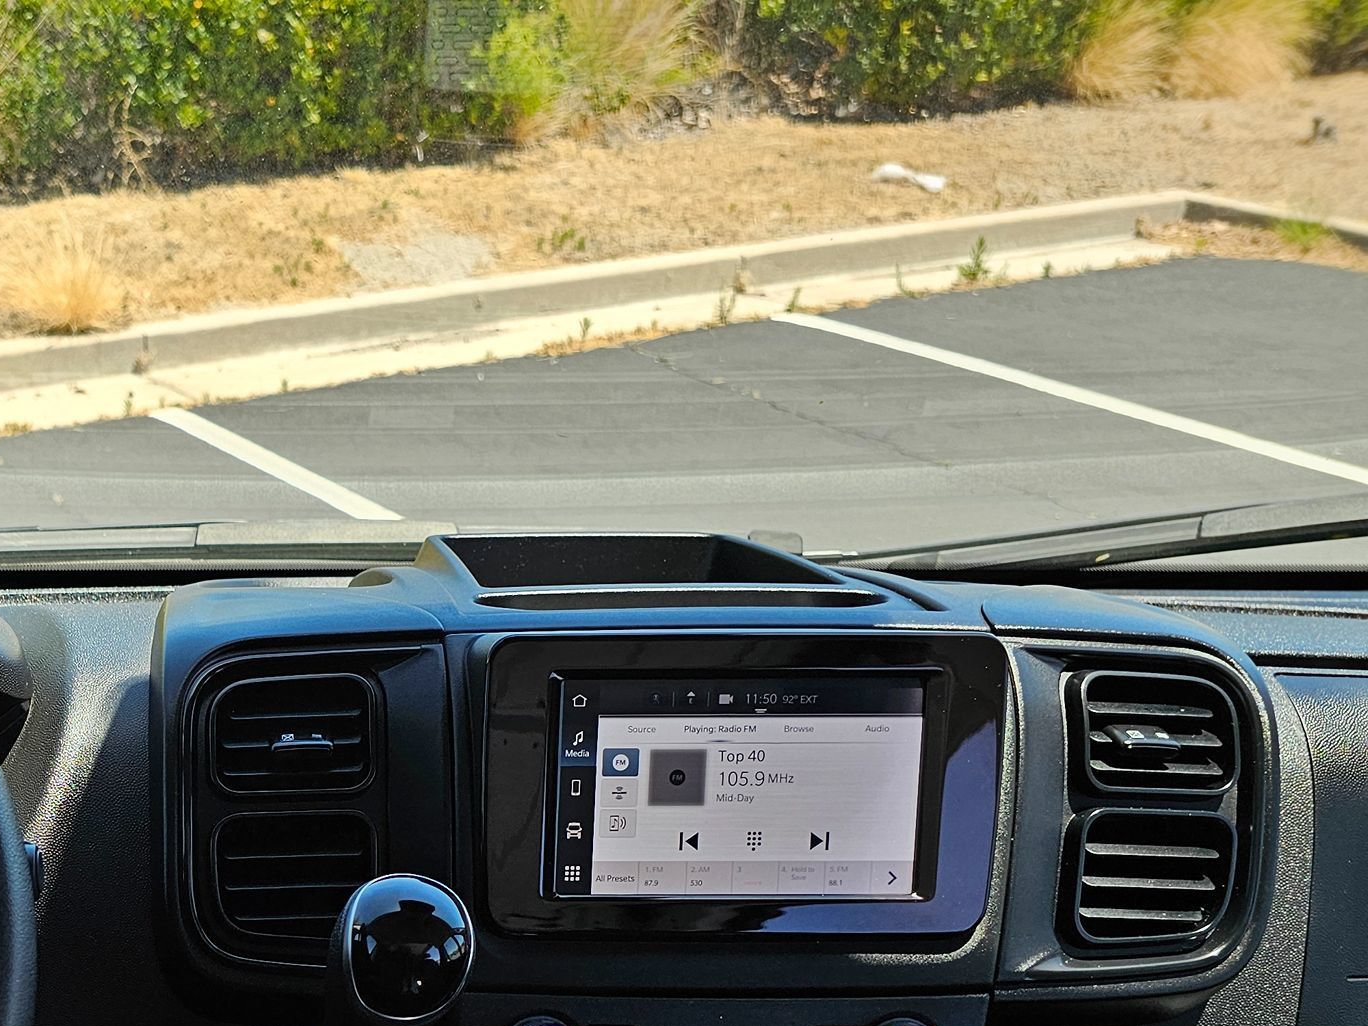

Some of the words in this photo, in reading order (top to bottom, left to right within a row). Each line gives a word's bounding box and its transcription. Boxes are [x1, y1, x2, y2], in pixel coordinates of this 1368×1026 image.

[746, 693, 777, 704] 11:50
[782, 694, 799, 704] 92°
[801, 695, 818, 704] EXT
[627, 725, 656, 733] Source
[684, 725, 717, 735] Playing:
[718, 725, 742, 733] Radio
[744, 725, 757, 733] FM
[783, 725, 814, 733] Browse
[865, 724, 890, 733] Audio
[718, 750, 745, 764] Top
[748, 750, 766, 762] 40
[719, 771, 765, 787] 105.9
[768, 773, 795, 784] MHz
[716, 794, 754, 804] Mid-Day
[607, 875, 635, 883] Presets
